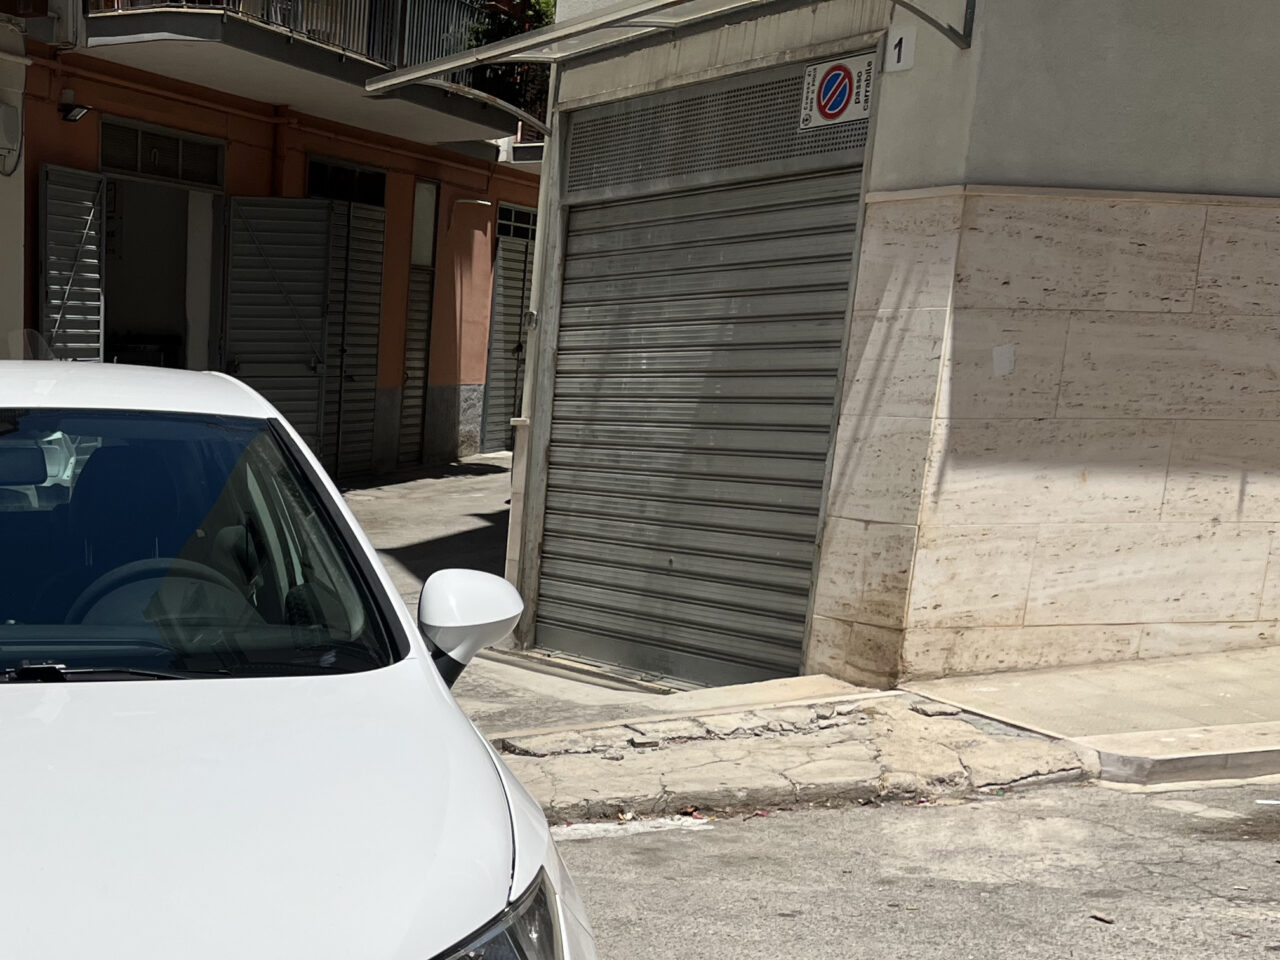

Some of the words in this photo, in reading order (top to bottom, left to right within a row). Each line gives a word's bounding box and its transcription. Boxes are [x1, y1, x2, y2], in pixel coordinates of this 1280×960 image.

[894, 37, 903, 63] 1
[854, 71, 863, 105] passo
[863, 61, 873, 111] carrabile
